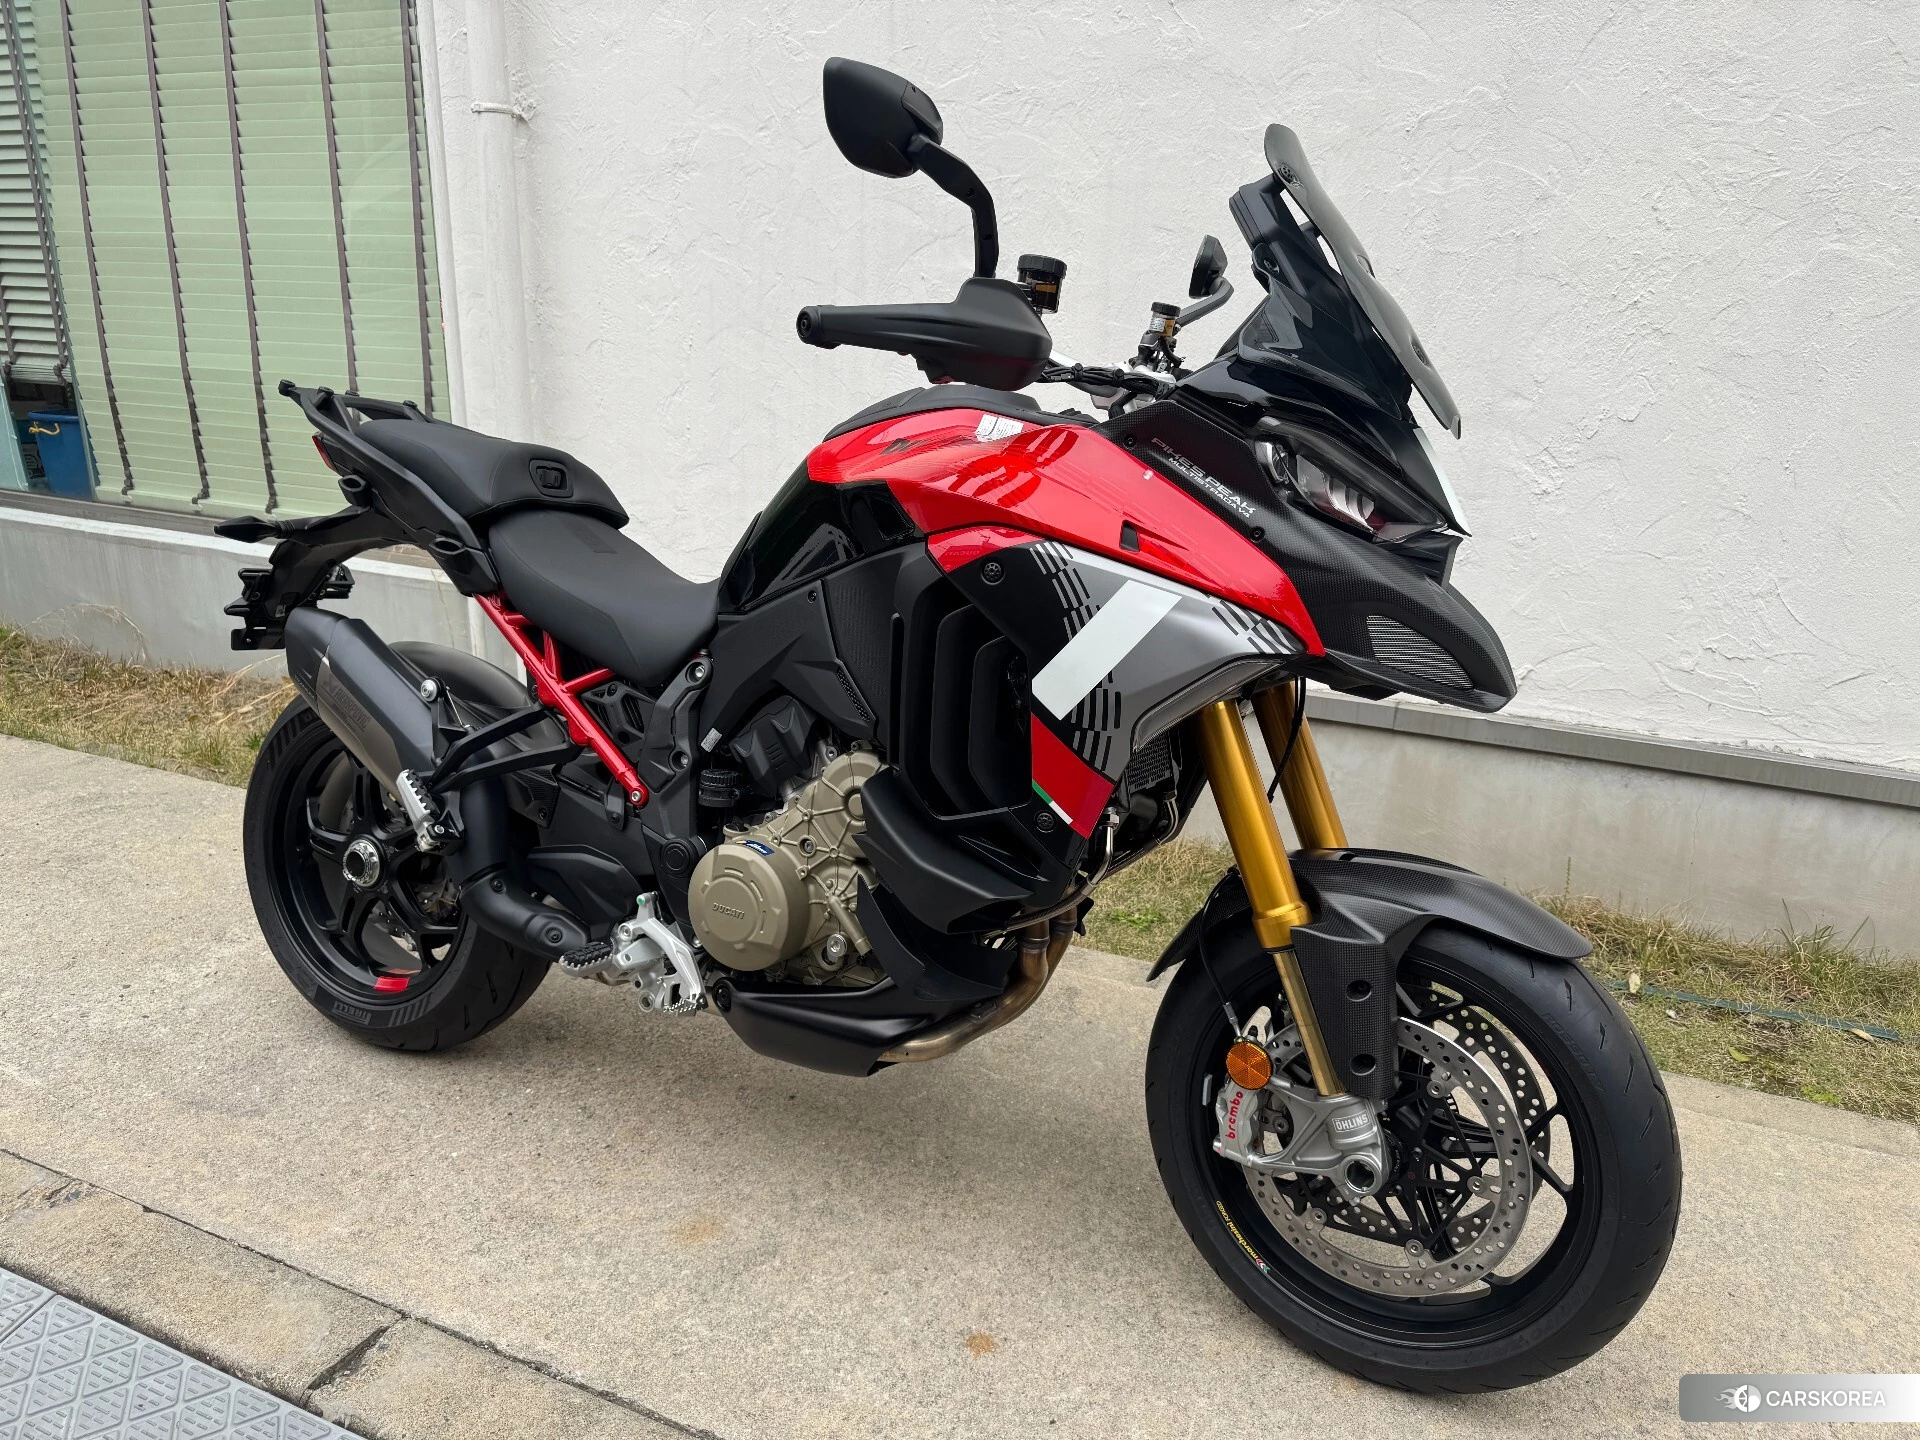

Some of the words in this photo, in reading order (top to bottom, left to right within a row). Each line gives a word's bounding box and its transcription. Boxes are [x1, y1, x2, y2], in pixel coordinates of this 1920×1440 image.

[1151, 437, 1206, 478] PIKES
[1204, 476, 1257, 514] PEAK
[1168, 457, 1237, 509] MULTISTRADA
[711, 902, 745, 920] DUCATI
[331, 1000, 372, 1026] PIRELLI
[1225, 1090, 1244, 1140] brembo
[1335, 1113, 1369, 1131] ÖHLINS
[1226, 1221, 1259, 1259] marchesini
